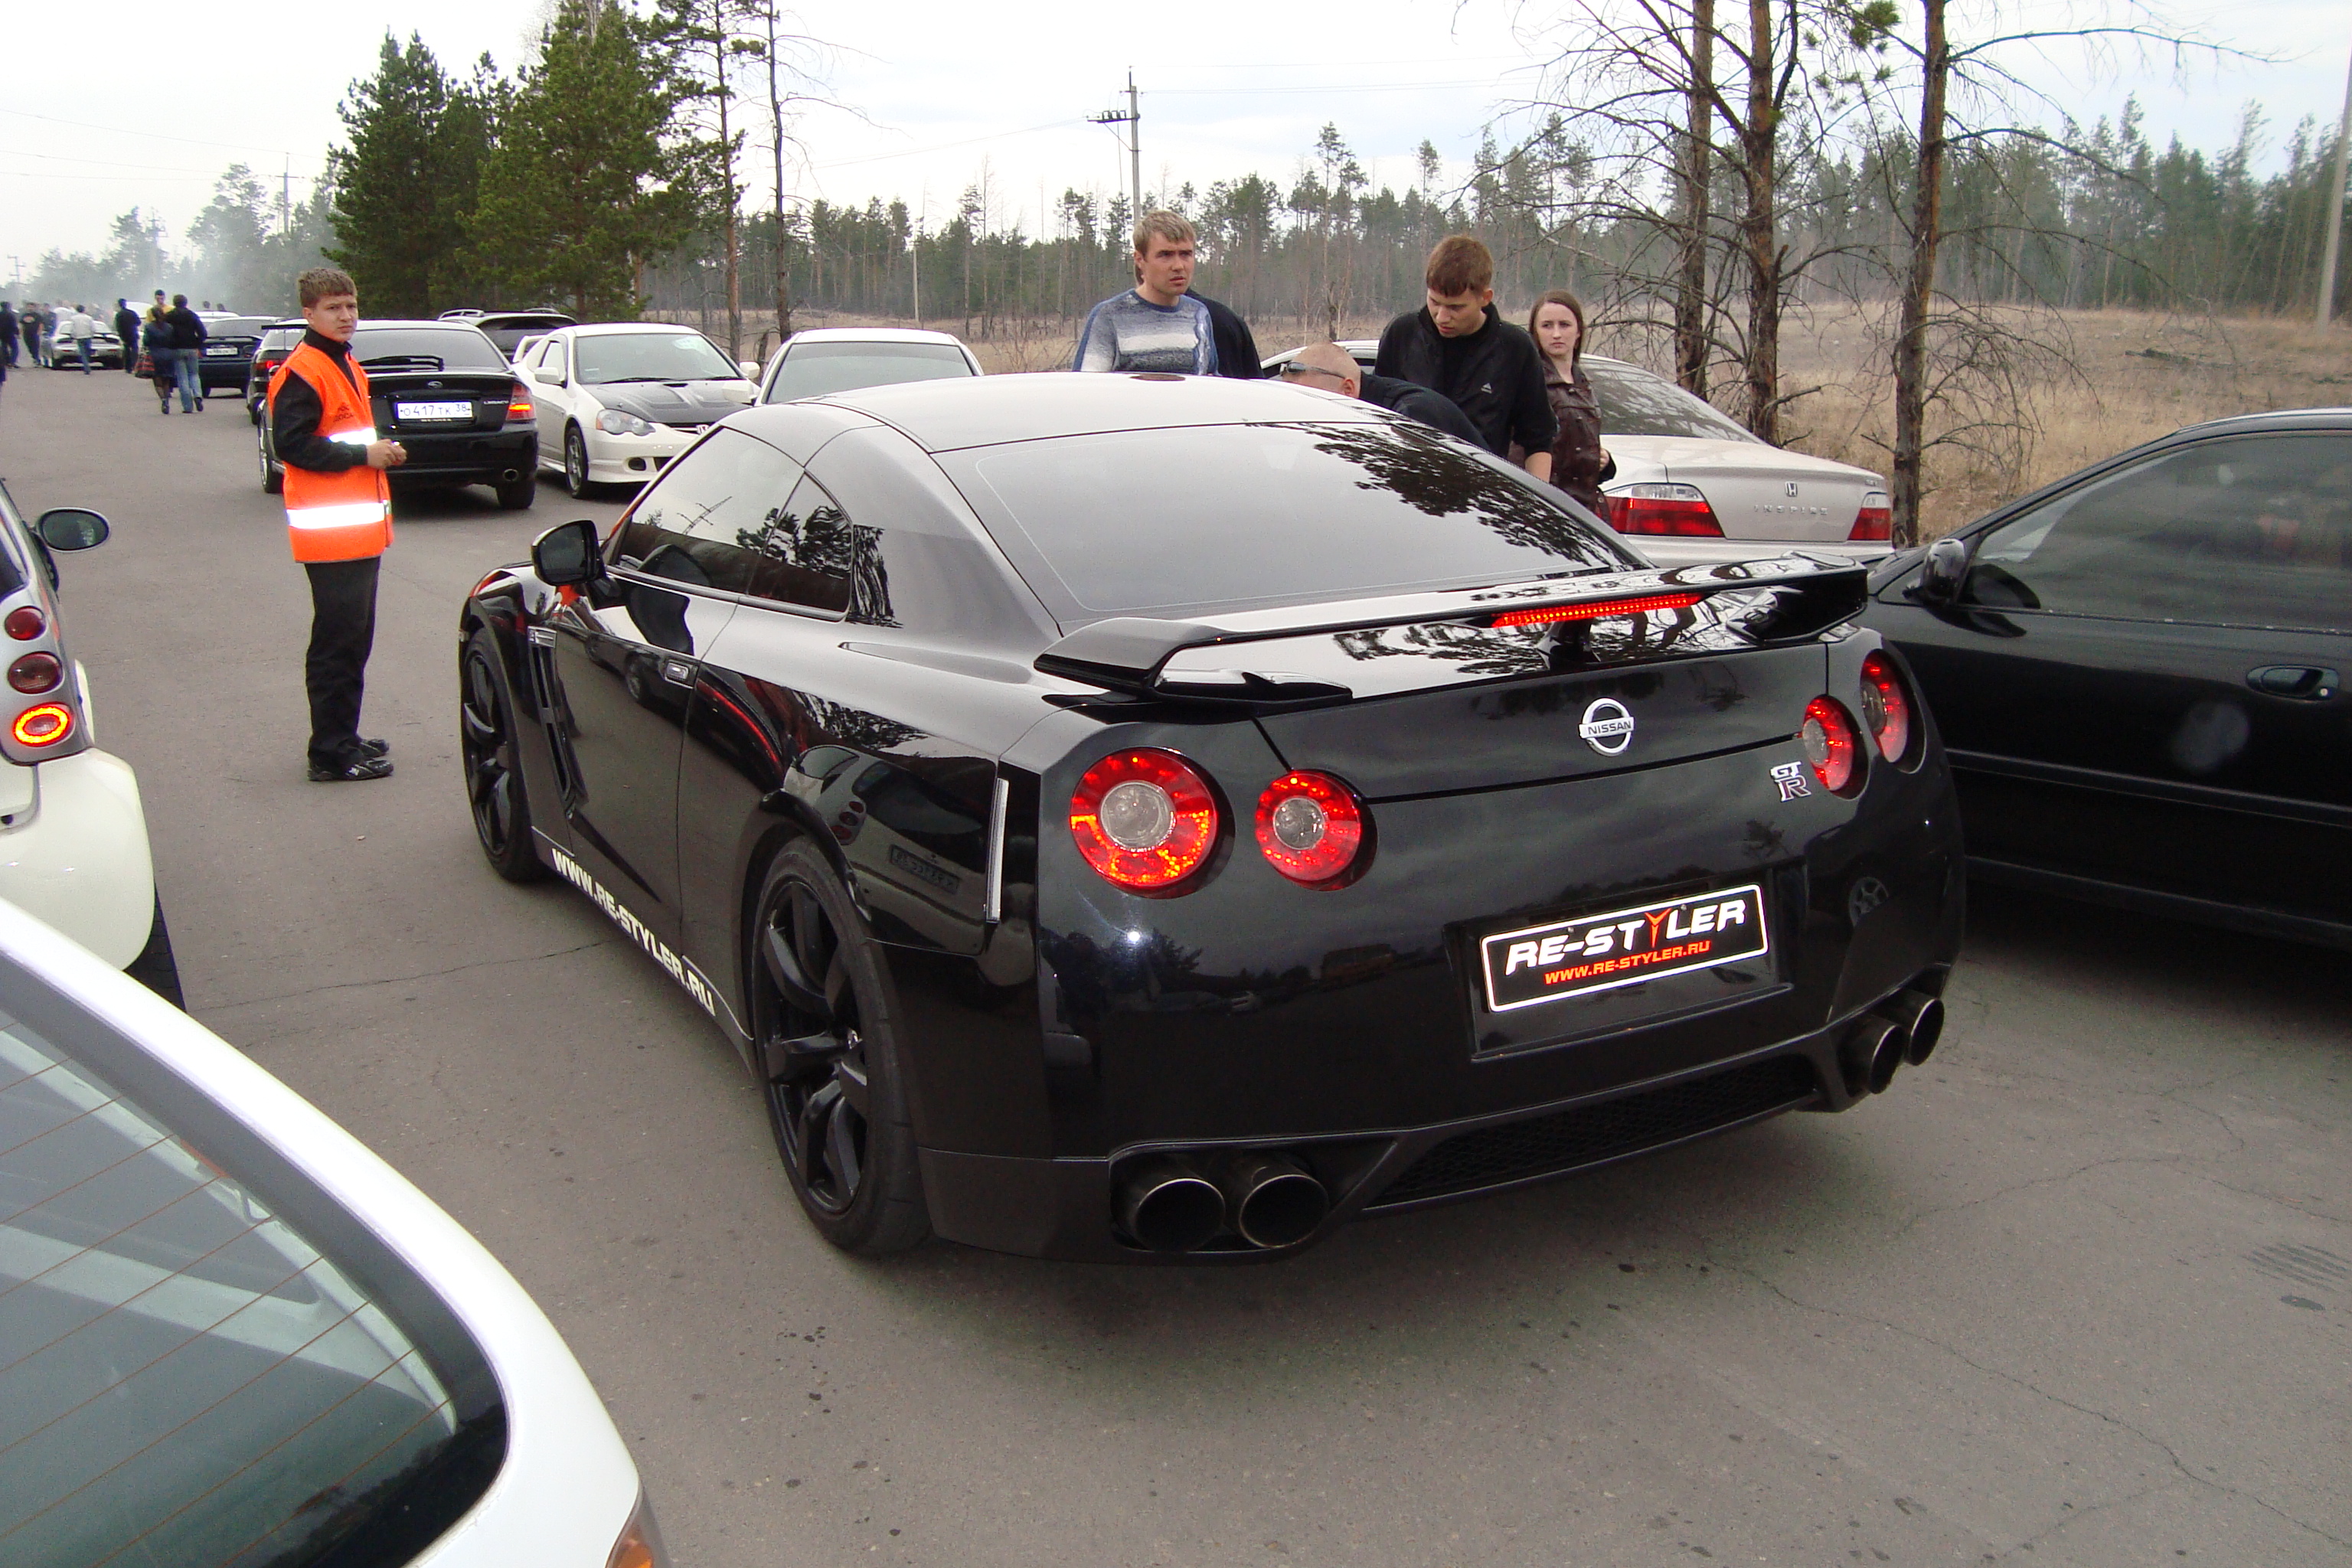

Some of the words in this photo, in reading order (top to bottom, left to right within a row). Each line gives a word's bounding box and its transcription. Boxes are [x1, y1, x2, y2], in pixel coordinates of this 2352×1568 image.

[1753, 504, 1828, 515] INSPIRE
[1586, 720, 1632, 735] NISSAN
[551, 848, 716, 1017] WWW.RE-STYLER.RU
[1504, 898, 1747, 976] RE-STYLER
[1544, 940, 1712, 985] WWW.RE-STYLER.RU
